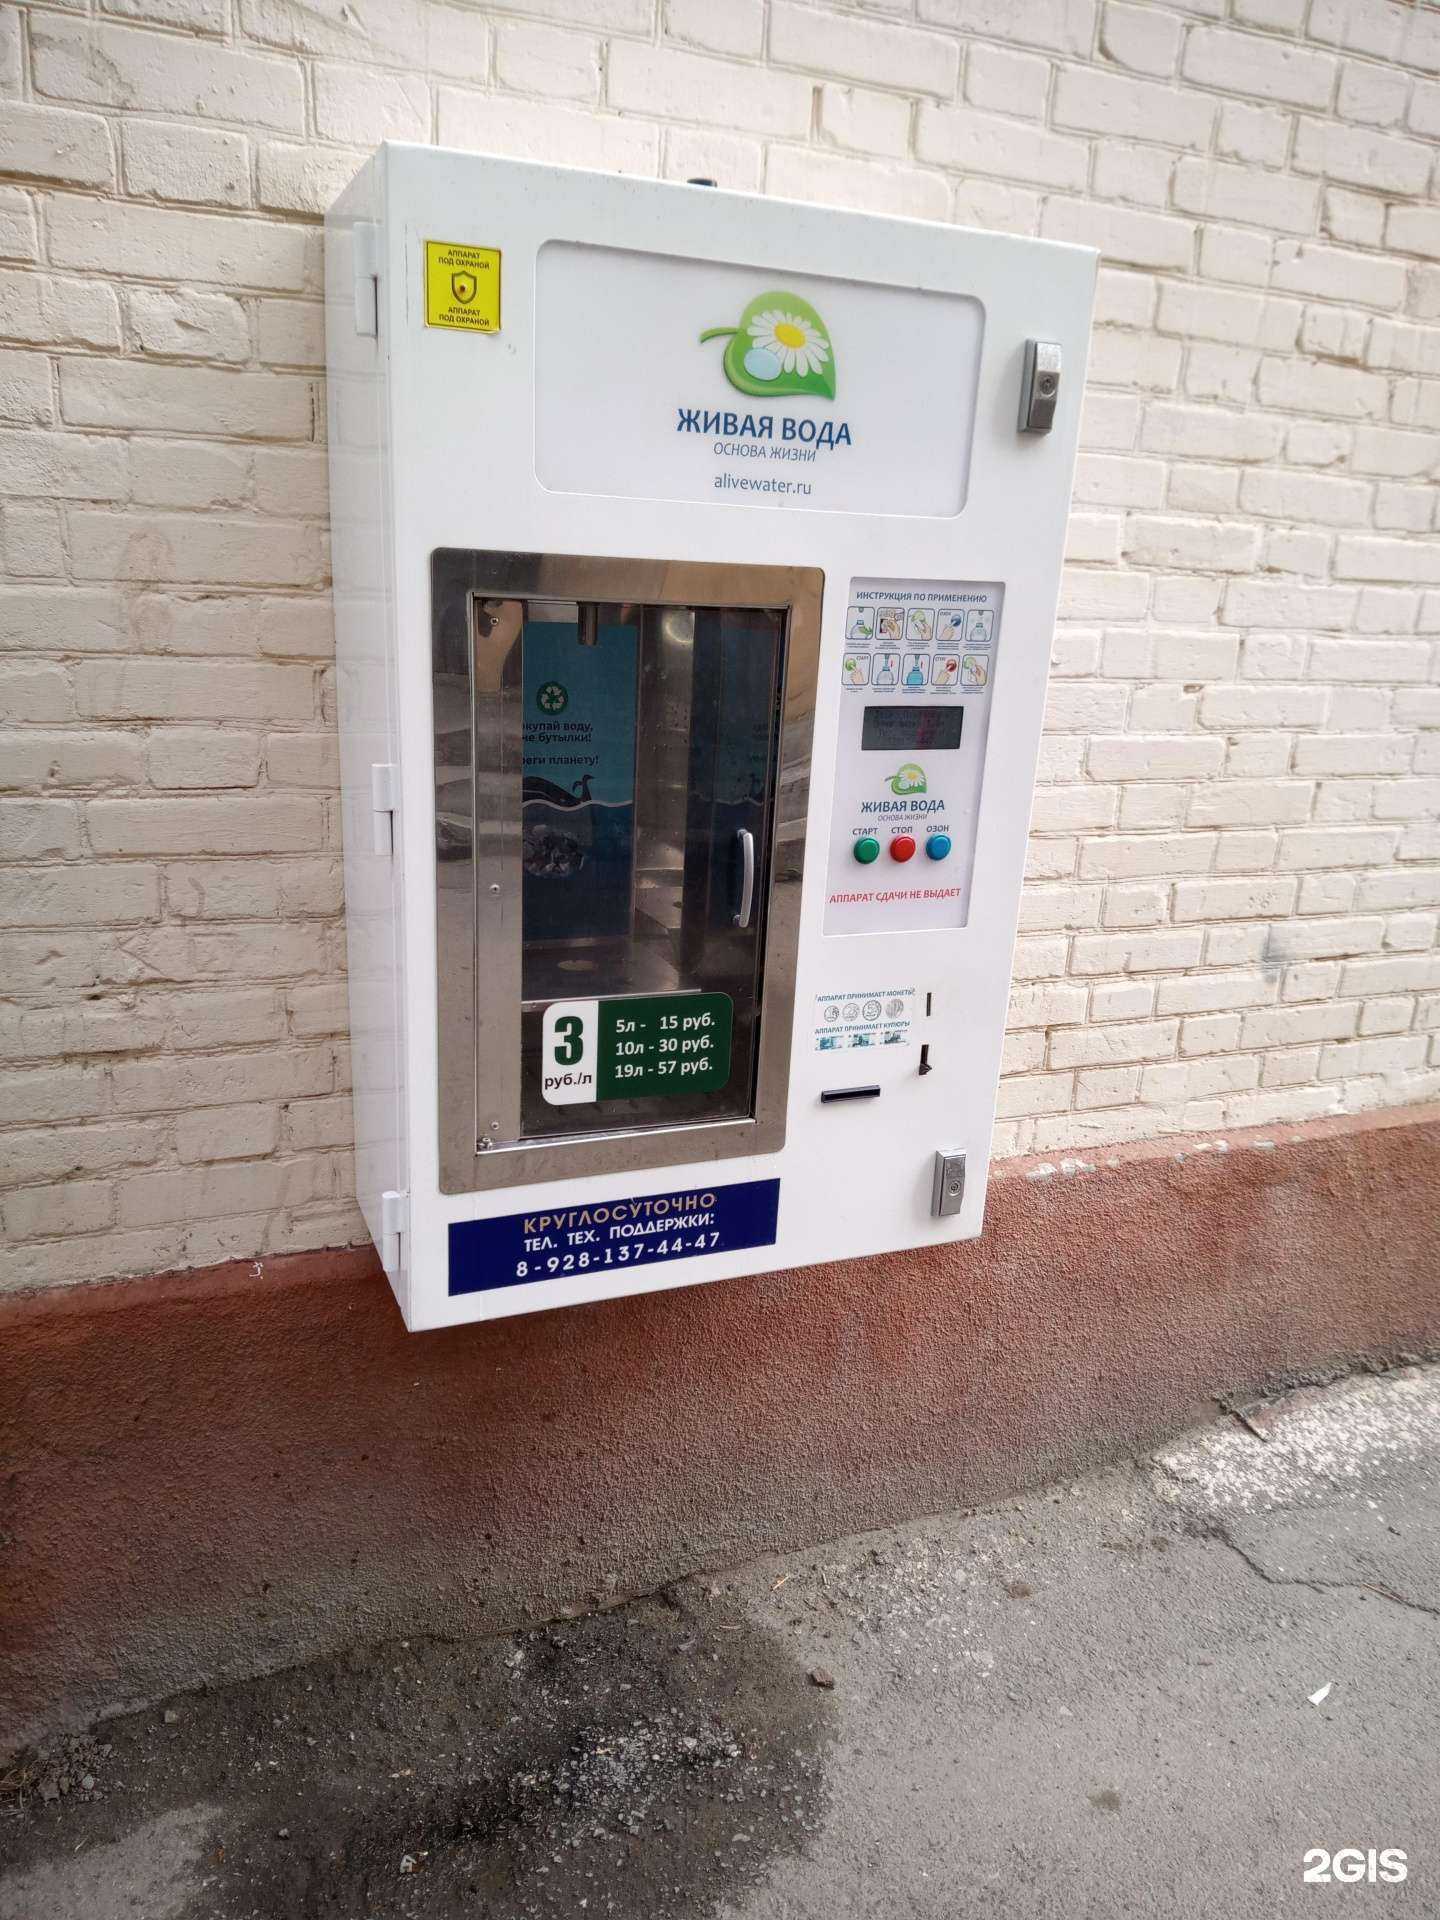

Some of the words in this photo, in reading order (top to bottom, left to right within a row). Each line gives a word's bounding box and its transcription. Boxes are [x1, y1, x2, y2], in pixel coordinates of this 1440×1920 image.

[448, 249, 480, 259] АППАРАТ
[438, 256, 454, 266] ПОД
[456, 258, 490, 269] ОХРАНОЙ
[448, 306, 480, 316] АППАРАТ
[439, 314, 454, 323] ПОД
[456, 315, 490, 326] ОХРАНОЙ
[676, 408, 773, 439] ЖИВАЯ
[782, 417, 852, 450] ВОДА
[713, 442, 766, 458] ОСНОВА
[770, 446, 816, 462] ЖИЗНИ
[714, 473, 812, 495] alivewater.ru
[856, 591, 912, 602] ИНСТРУКЦИЯ
[914, 593, 925, 601] ПО
[927, 593, 987, 603] ПРИМЕНЕНИЮ
[522, 722, 560, 733] купай
[563, 722, 593, 733] воду,
[538, 732, 592, 743] бутылки!
[549, 755, 599, 766] планету!
[861, 801, 907, 813] ЖИВАЯ
[910, 800, 945, 813] ВОДА
[878, 814, 904, 822] ОСНОВА
[905, 813, 927, 821] ЖИЗНИ
[852, 827, 879, 836] СТАРТ
[891, 826, 913, 834] СТОП
[926, 825, 949, 833] ОЗОН
[830, 892, 875, 903] АППАРАТ
[876, 891, 907, 902] СДАЧИ
[910, 889, 921, 899] НЕ
[924, 888, 961, 899] ВЫДАЕТ
[817, 994, 846, 1002] АППАРАТ
[616, 1019, 635, 1033] 5л
[660, 1016, 678, 1030] 15
[683, 1012, 716, 1031] руб.
[815, 1026, 843, 1034] АППАРАТ
[554, 1016, 584, 1066] 3
[615, 1041, 644, 1056] 10л
[659, 1038, 677, 1052] 30
[682, 1035, 714, 1054] руб.
[615, 1063, 643, 1079] 19л
[657, 1060, 676, 1075] 57
[681, 1057, 713, 1076] руб.
[544, 1073, 592, 1090] руб./л
[523, 1192, 717, 1234] КРУГЛОСУТОЧНО
[524, 1238, 558, 1253] ТЕЛ.
[567, 1231, 600, 1246] ТЕХ.
[609, 1211, 715, 1240] ПОДДЕРЖКИ:
[516, 1231, 720, 1278] 8-928-137-44-47
